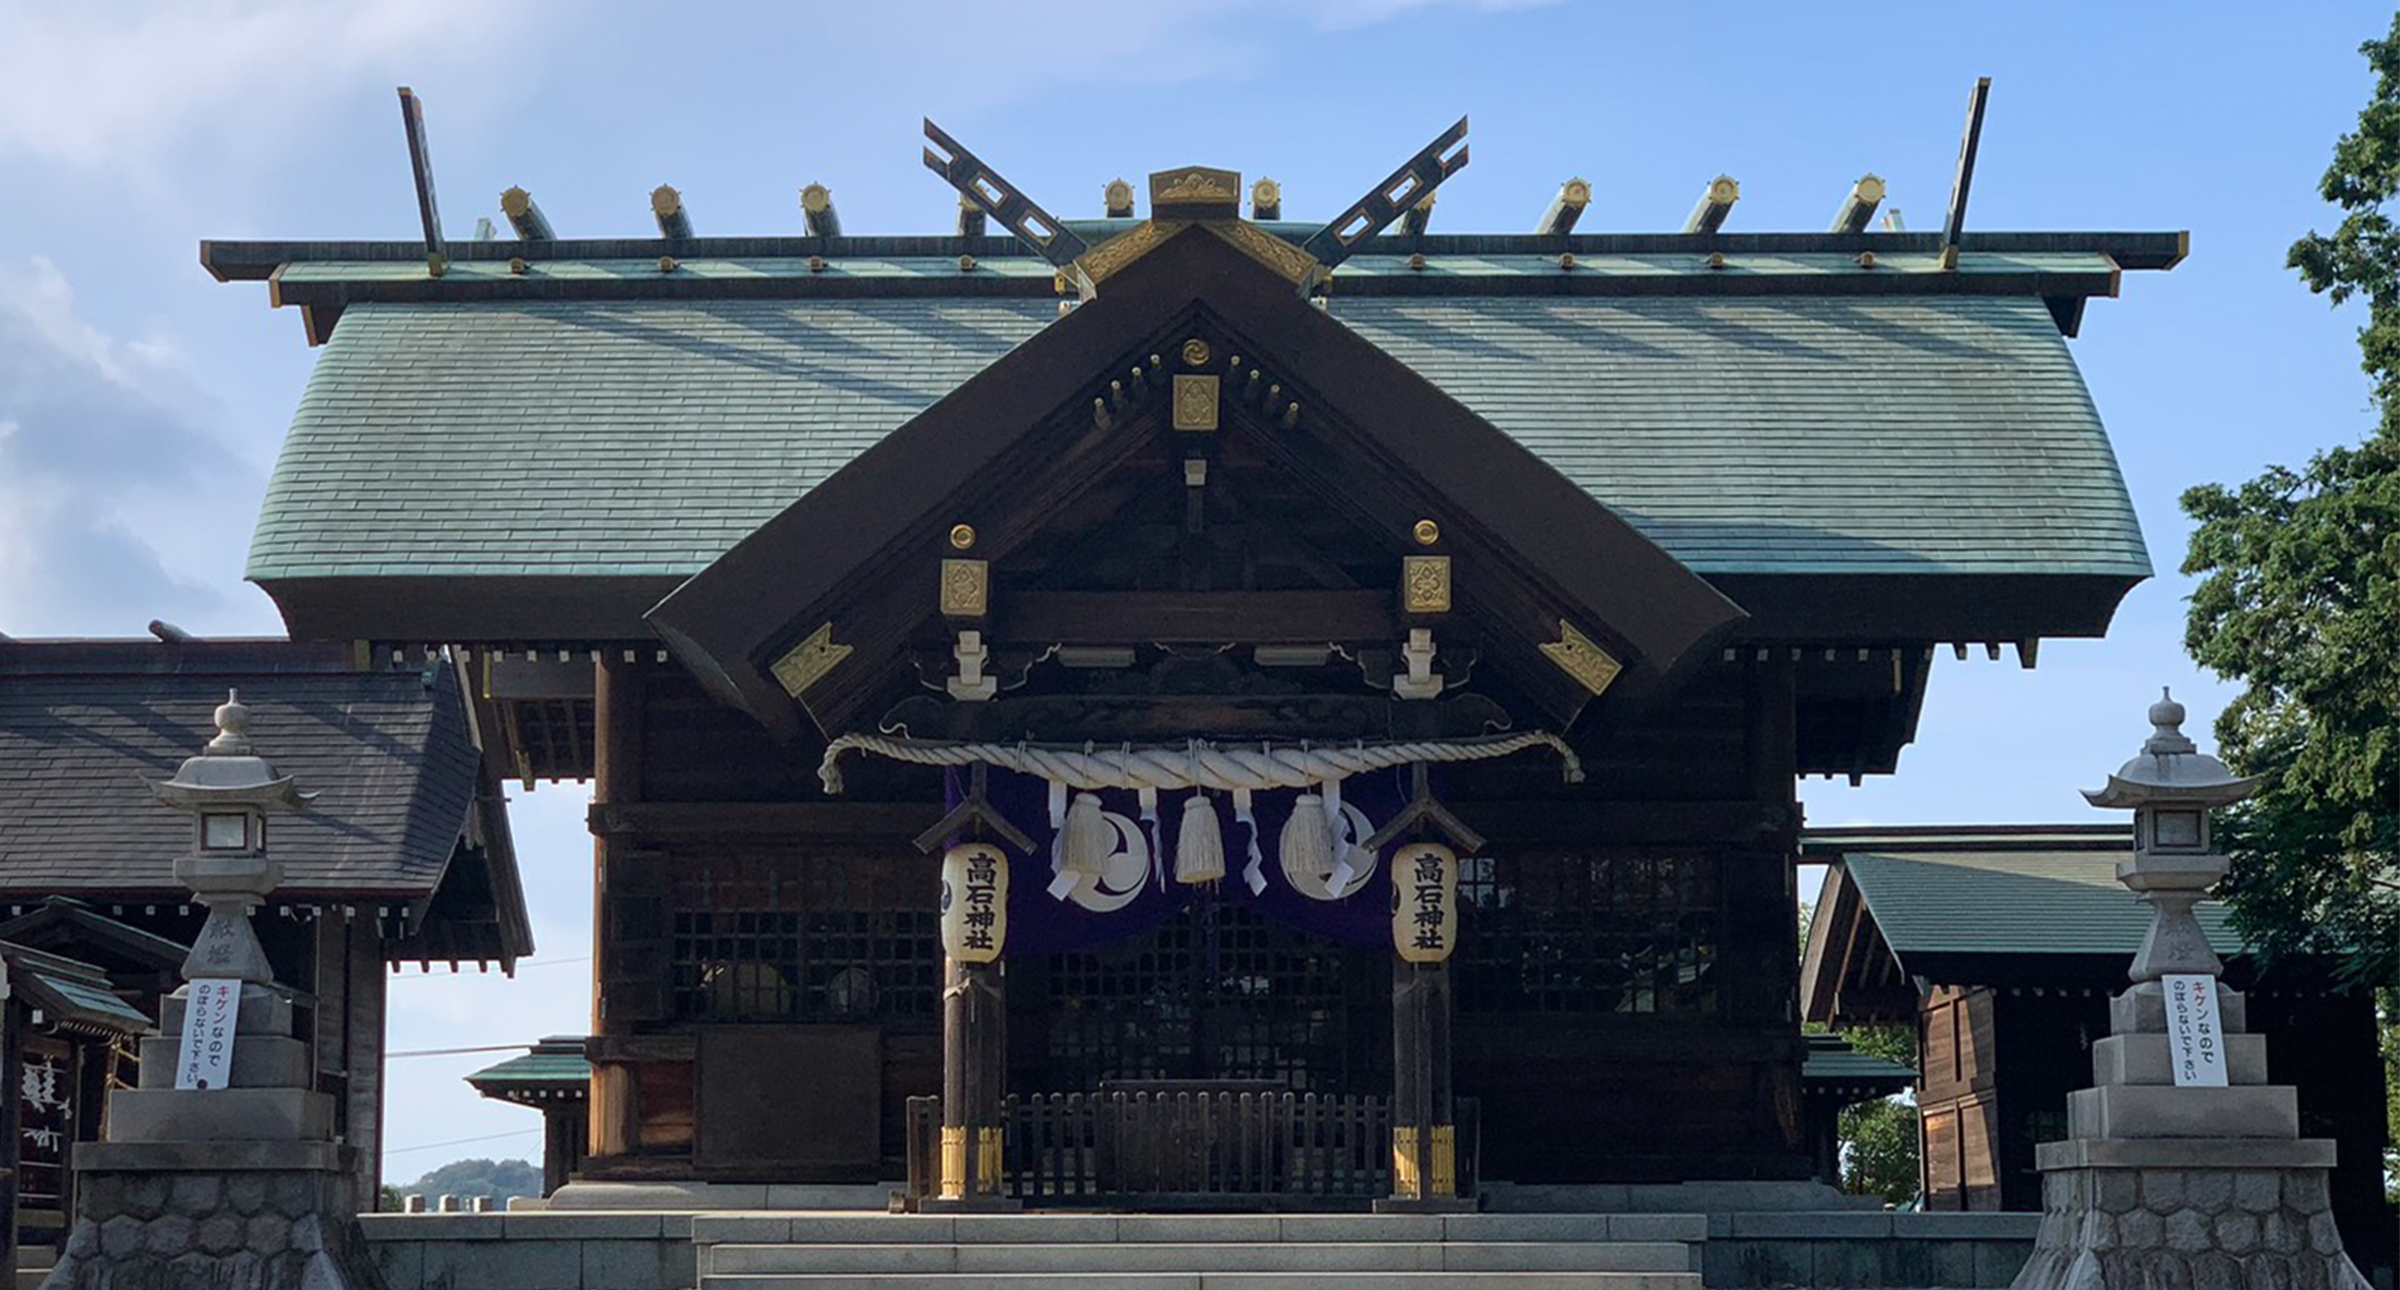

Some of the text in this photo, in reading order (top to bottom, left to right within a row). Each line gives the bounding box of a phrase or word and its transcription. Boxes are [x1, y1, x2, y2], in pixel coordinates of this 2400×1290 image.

[963, 852, 996, 950] 高石神社
[1411, 853, 1443, 950] 高石神社
[186, 984, 211, 1083] のぼらないで下さい
[208, 985, 230, 1067] キケンなので
[2172, 980, 2197, 1081] のぼらないで下さい
[2192, 980, 2214, 1064] キケンなので
